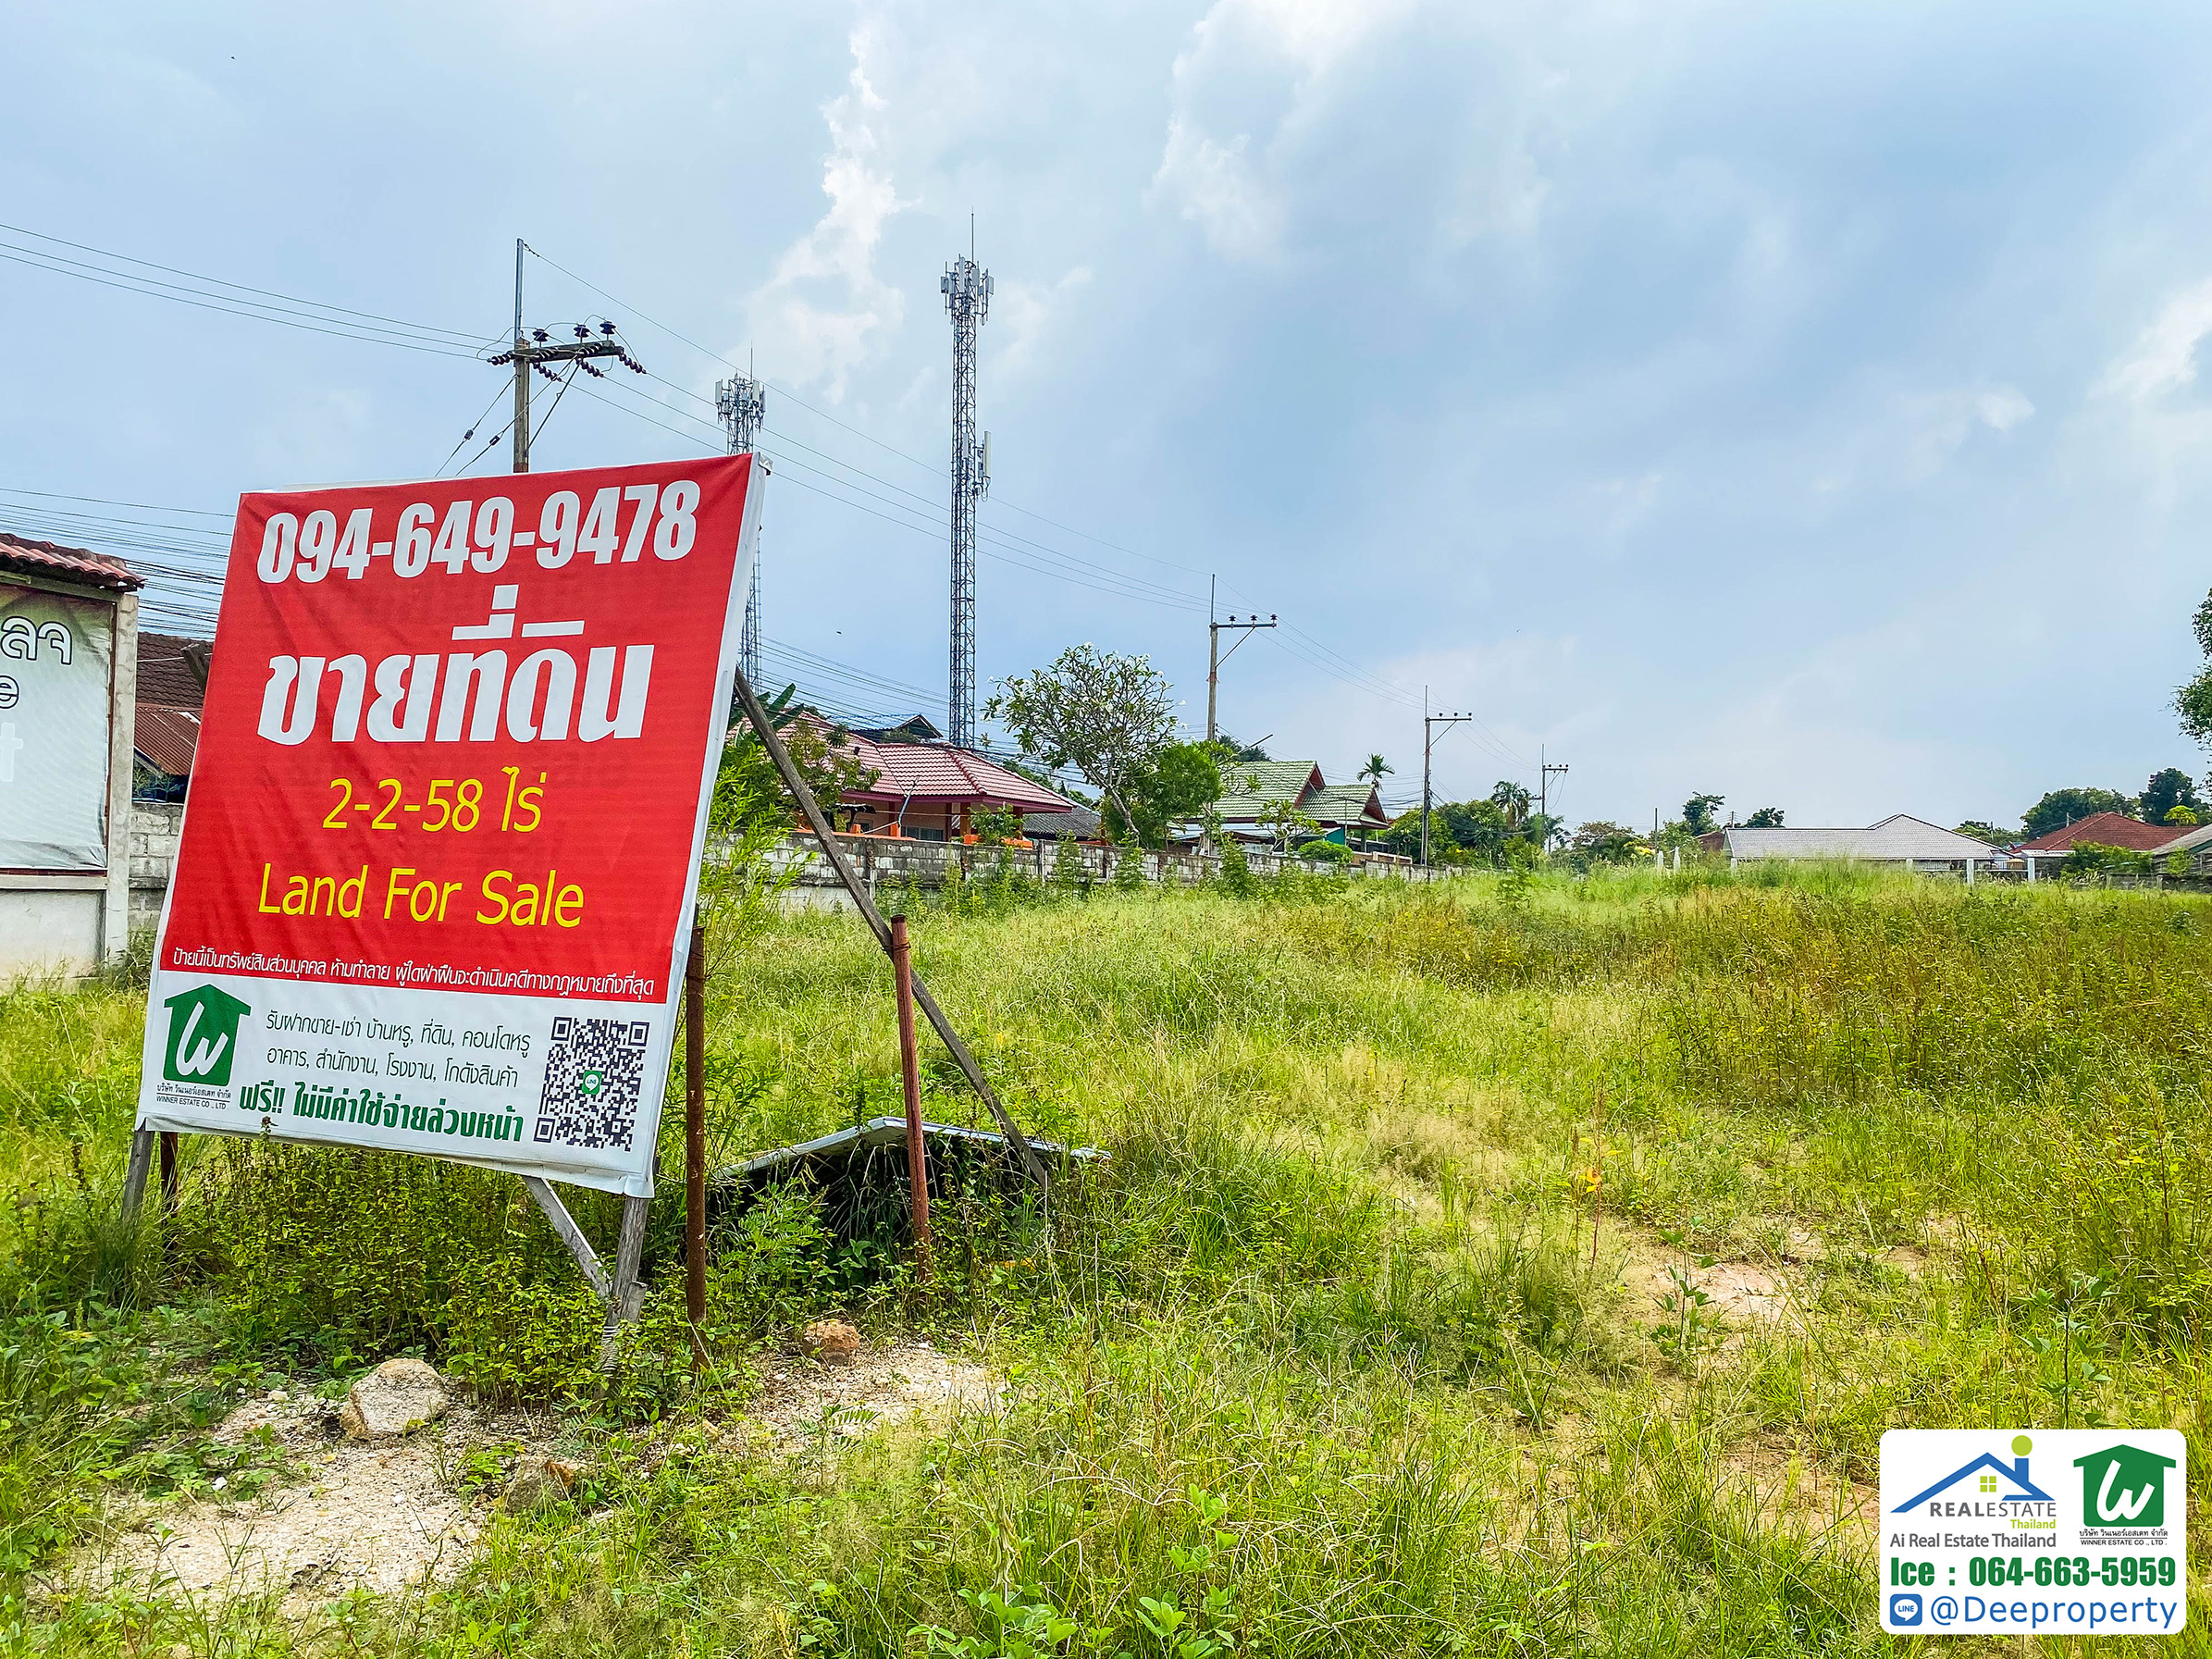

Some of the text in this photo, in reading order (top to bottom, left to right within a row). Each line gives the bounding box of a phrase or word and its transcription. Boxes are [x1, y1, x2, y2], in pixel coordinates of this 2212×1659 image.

[256, 479, 700, 584] 094-649-9478
[257, 584, 655, 746] ขายที่ดิน
[322, 766, 548, 833] 2-2-58 ไร่
[258, 862, 585, 928] Land For Sale
[330, 959, 390, 981] ห้ามทำลาย
[266, 1009, 531, 1059] รับฝากขาย-เช่า บ้านหรู, ที่ดิน, คอนโดหรู
[266, 1047, 518, 1088] อาคาร, สำนักงาน, โรงงาน, โกดังสินค้า
[156, 1096, 179, 1104] WINNER
[179, 1098, 201, 1107] ESTATE
[239, 1080, 525, 1143] ฟรี!! ไม่มีค่าใช้จ่ายล่วงหน้า
